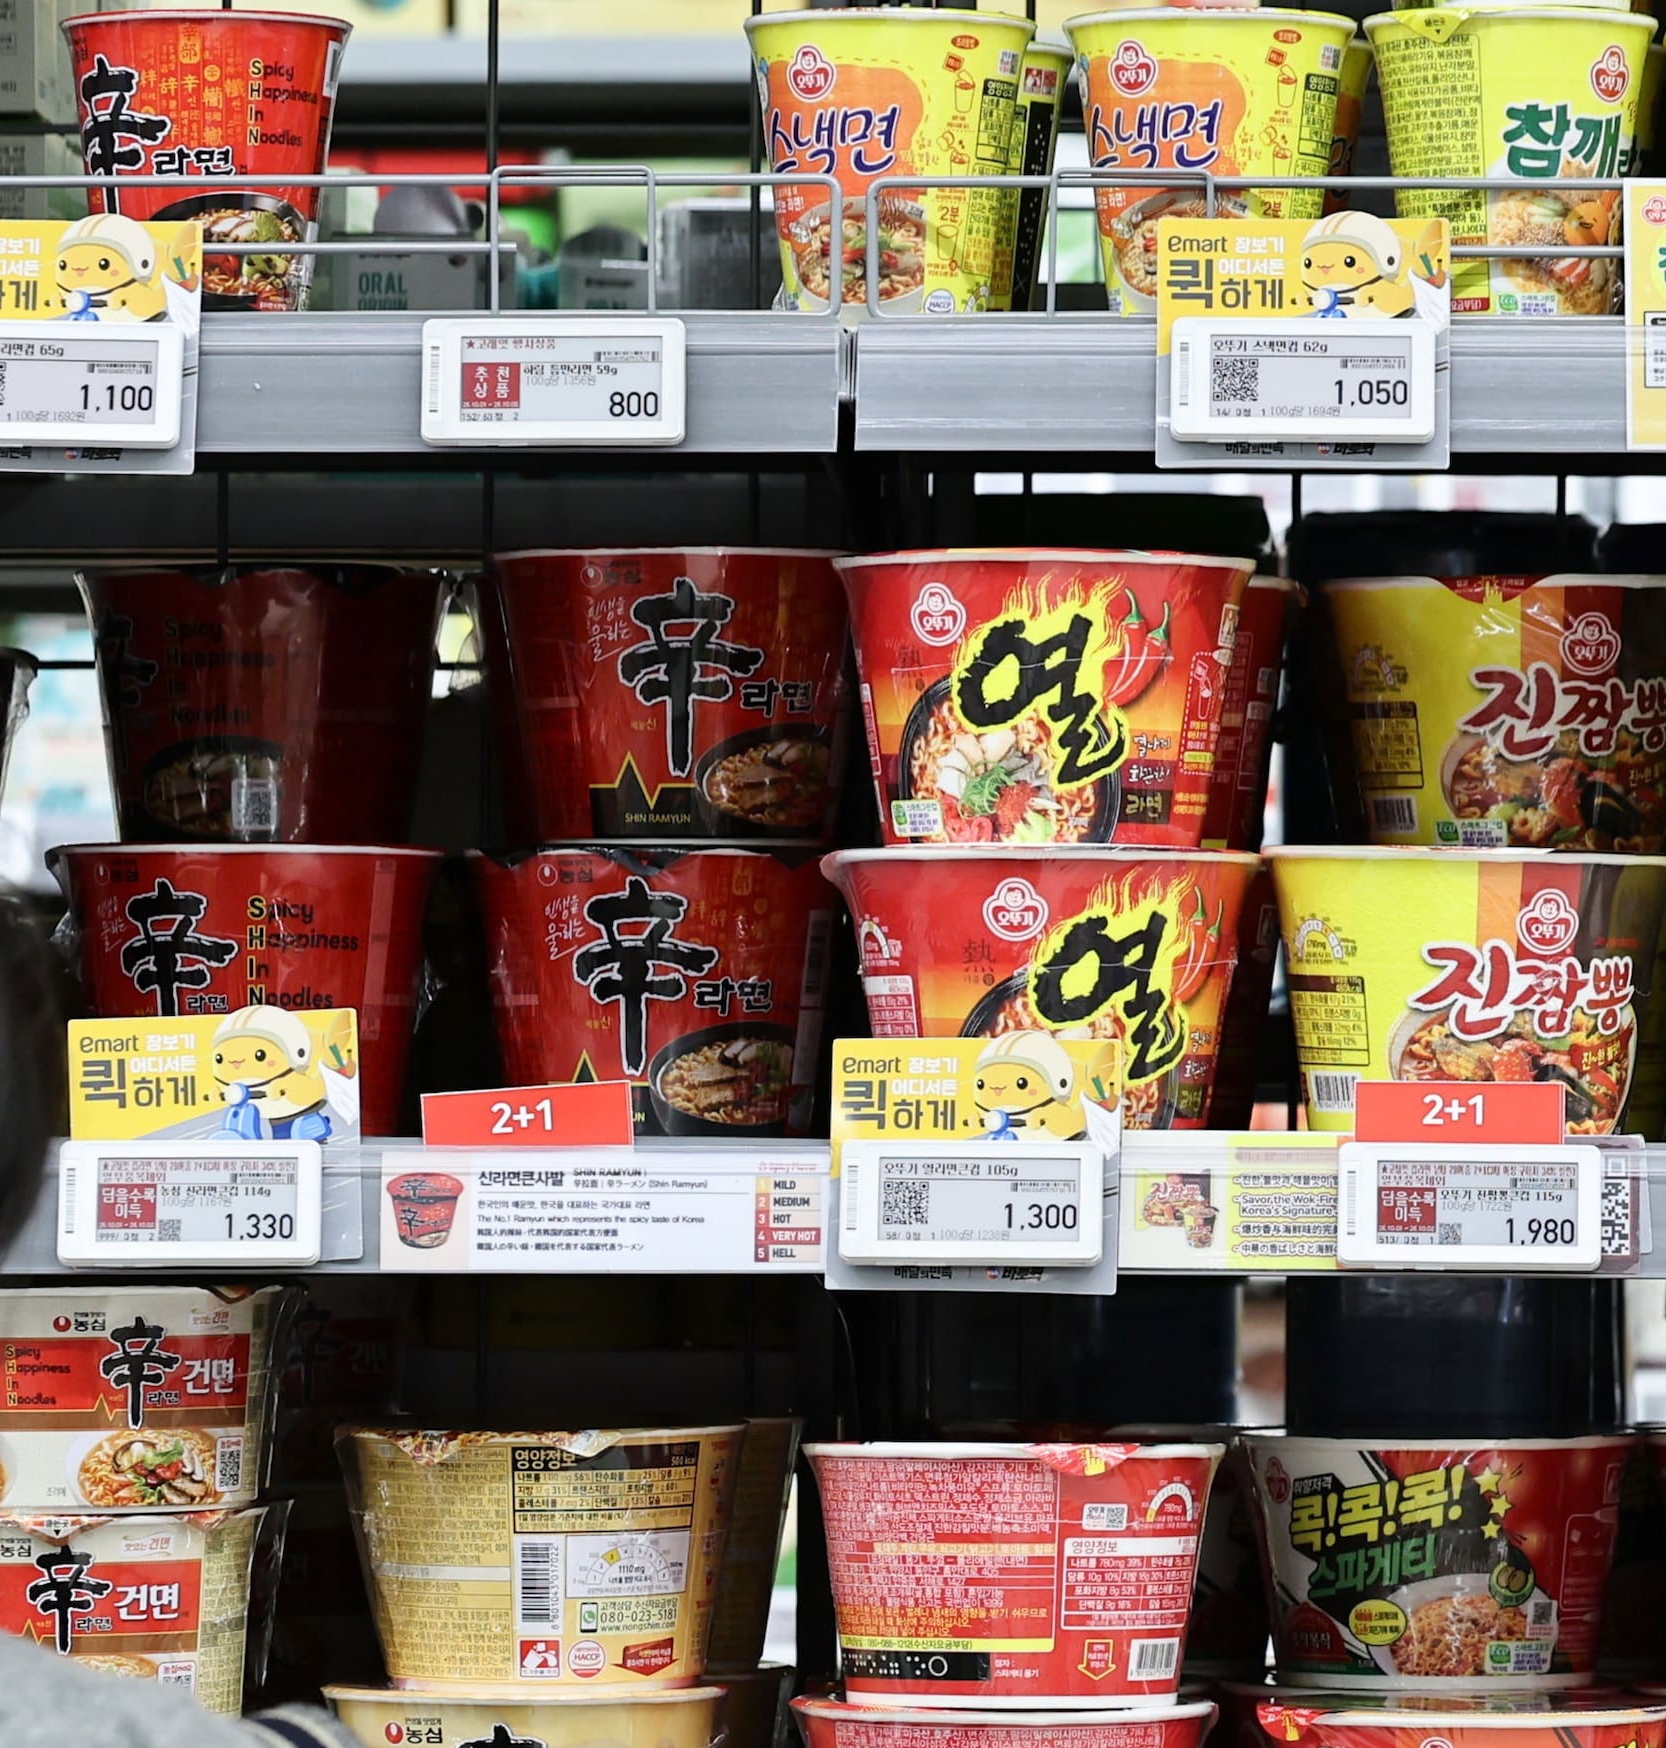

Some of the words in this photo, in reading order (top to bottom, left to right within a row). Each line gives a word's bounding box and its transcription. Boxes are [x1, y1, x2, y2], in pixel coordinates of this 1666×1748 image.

[250, 59, 295, 81] Spicy
[249, 83, 319, 106] Happiness
[248, 127, 304, 149] Noodles
[1167, 233, 1227, 254] emart
[1234, 236, 1285, 254] 장보기
[1218, 258, 1284, 276] 어디서든
[358, 273, 408, 294] ORAL
[78, 384, 153, 412] 1,100
[607, 391, 660, 419] 800
[1334, 378, 1409, 409] 1,050
[618, 578, 764, 778] 辛
[740, 679, 814, 717] 라면
[958, 612, 1126, 780] 열
[624, 812, 646, 825] SHIN
[649, 812, 691, 826] RAMYUN
[247, 896, 314, 926] Spicy
[247, 928, 359, 956] Happiness
[569, 875, 716, 1076] 辛
[693, 976, 773, 1013] 라면
[1412, 940, 1633, 1040] 진짬뽕
[491, 1099, 554, 1134] 2+1
[1421, 1093, 1485, 1126] 2+1
[225, 1213, 294, 1241] 1,330
[1005, 1203, 1078, 1231] 1,300
[1505, 1217, 1575, 1245] 1,980
[773, 1231, 795, 1241] VERY
[797, 1231, 815, 1241] HOT
[101, 1317, 178, 1428] 辛
[183, 1358, 236, 1396] 건면
[1290, 1464, 1467, 1546] 콕!콕!콕!
[1308, 1538, 1438, 1601] 스파게티
[114, 1585, 181, 1619] 건면
[601, 1609, 677, 1623] 080-023-5181
[601, 1621, 676, 1632] www.nongshim.com
[575, 1653, 600, 1661] HACCP
